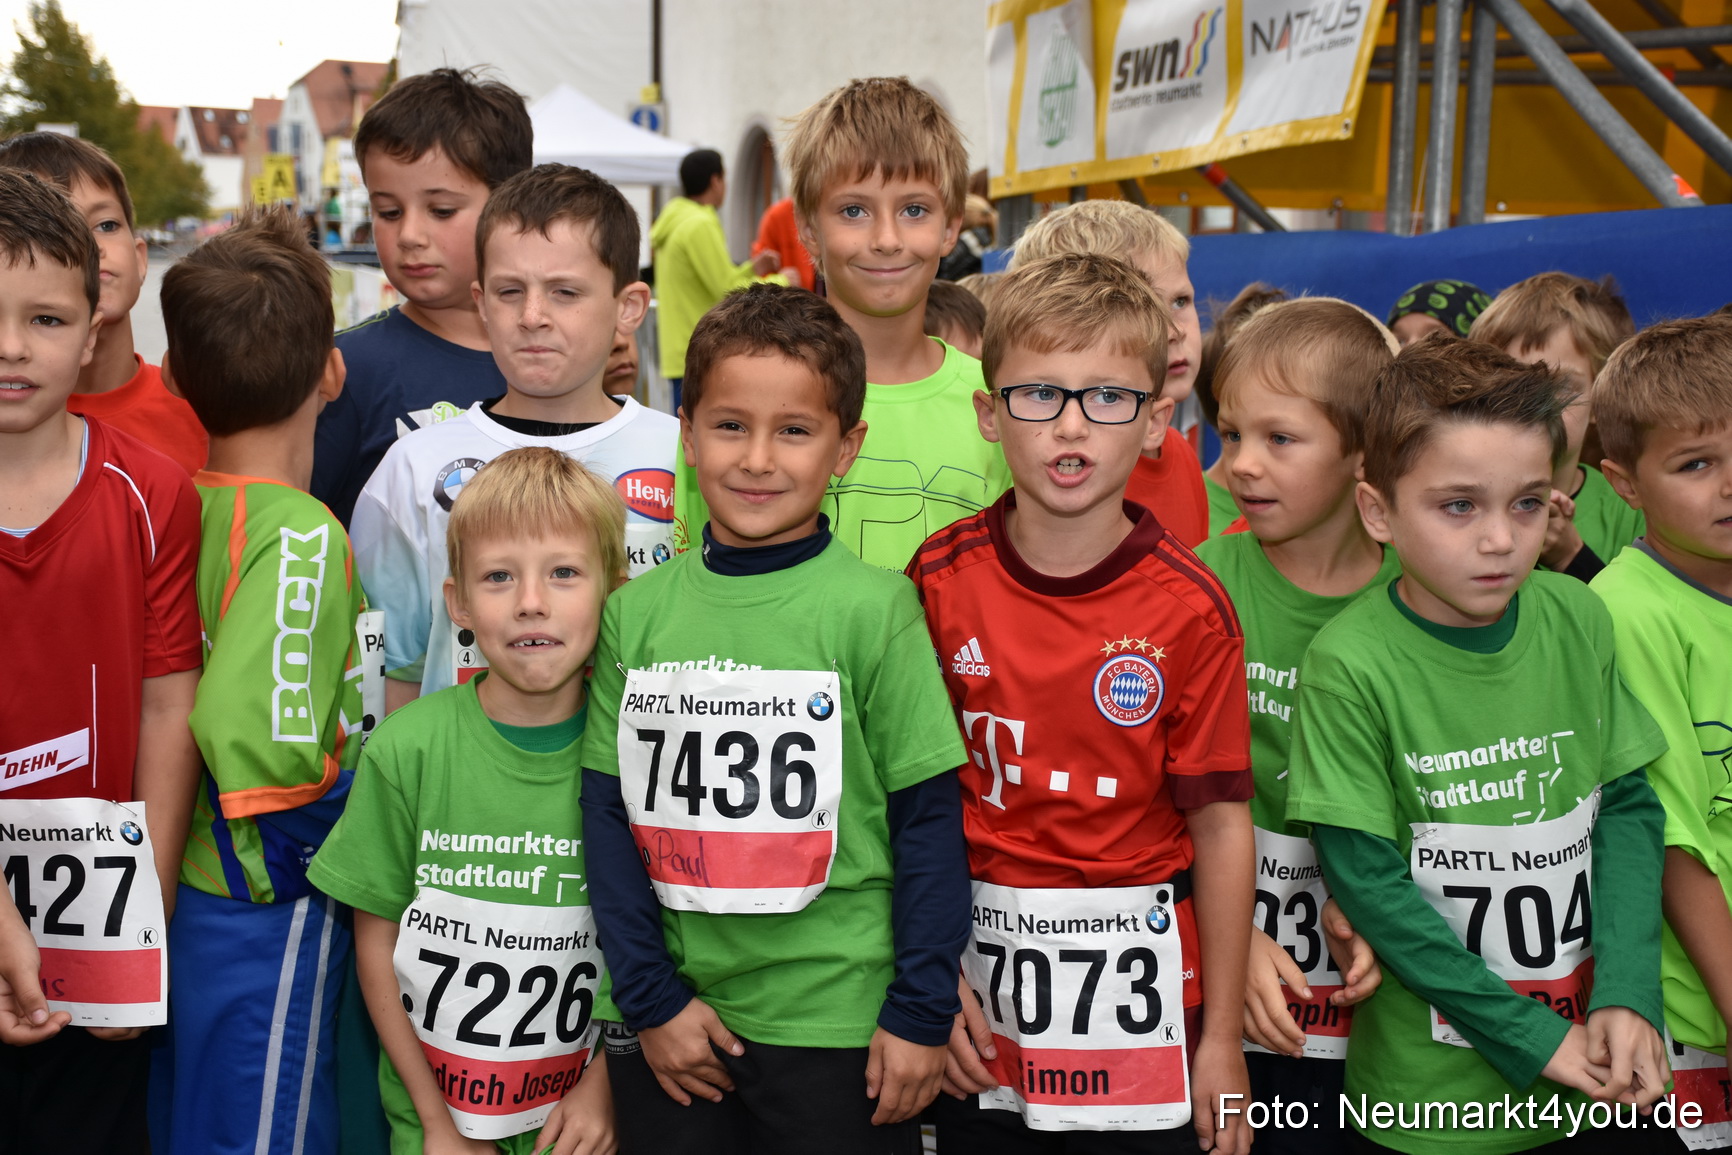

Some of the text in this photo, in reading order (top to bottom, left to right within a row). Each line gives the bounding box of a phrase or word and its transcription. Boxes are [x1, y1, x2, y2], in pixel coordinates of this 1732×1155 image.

[1114, 37, 1180, 93] swn
[272, 523, 329, 742] BOCK
[463, 652, 471, 665] 4
[951, 660, 991, 677] adidas
[1107, 662, 1157, 693] FC BAYERN
[624, 693, 796, 717] PARTL Neumarkt
[1101, 694, 1146, 720] MÜNCHEN
[1247, 689, 1294, 723] tlau
[4, 750, 59, 779] DEHN
[1404, 733, 1549, 774] Neumarkter
[636, 728, 817, 820] 7436
[1416, 769, 1528, 809] Stadtlauf
[0, 822, 115, 842] Neumarkt
[815, 812, 826, 826] K
[420, 828, 583, 857] Neumarkter
[652, 829, 712, 889] Paul
[1260, 856, 1324, 881] Neuma
[1417, 847, 1506, 872] PARTL
[415, 863, 548, 894] Stadtlauf
[3, 853, 137, 938] 427
[406, 908, 590, 951] PARTL Neumarkt
[1018, 912, 1140, 935] Neumarkt
[1254, 889, 1341, 974] 03
[1442, 868, 1593, 969] 704
[143, 930, 153, 944] K
[418, 947, 598, 1048] 7226
[976, 940, 1163, 1036] 7073
[1164, 1025, 1175, 1042] K
